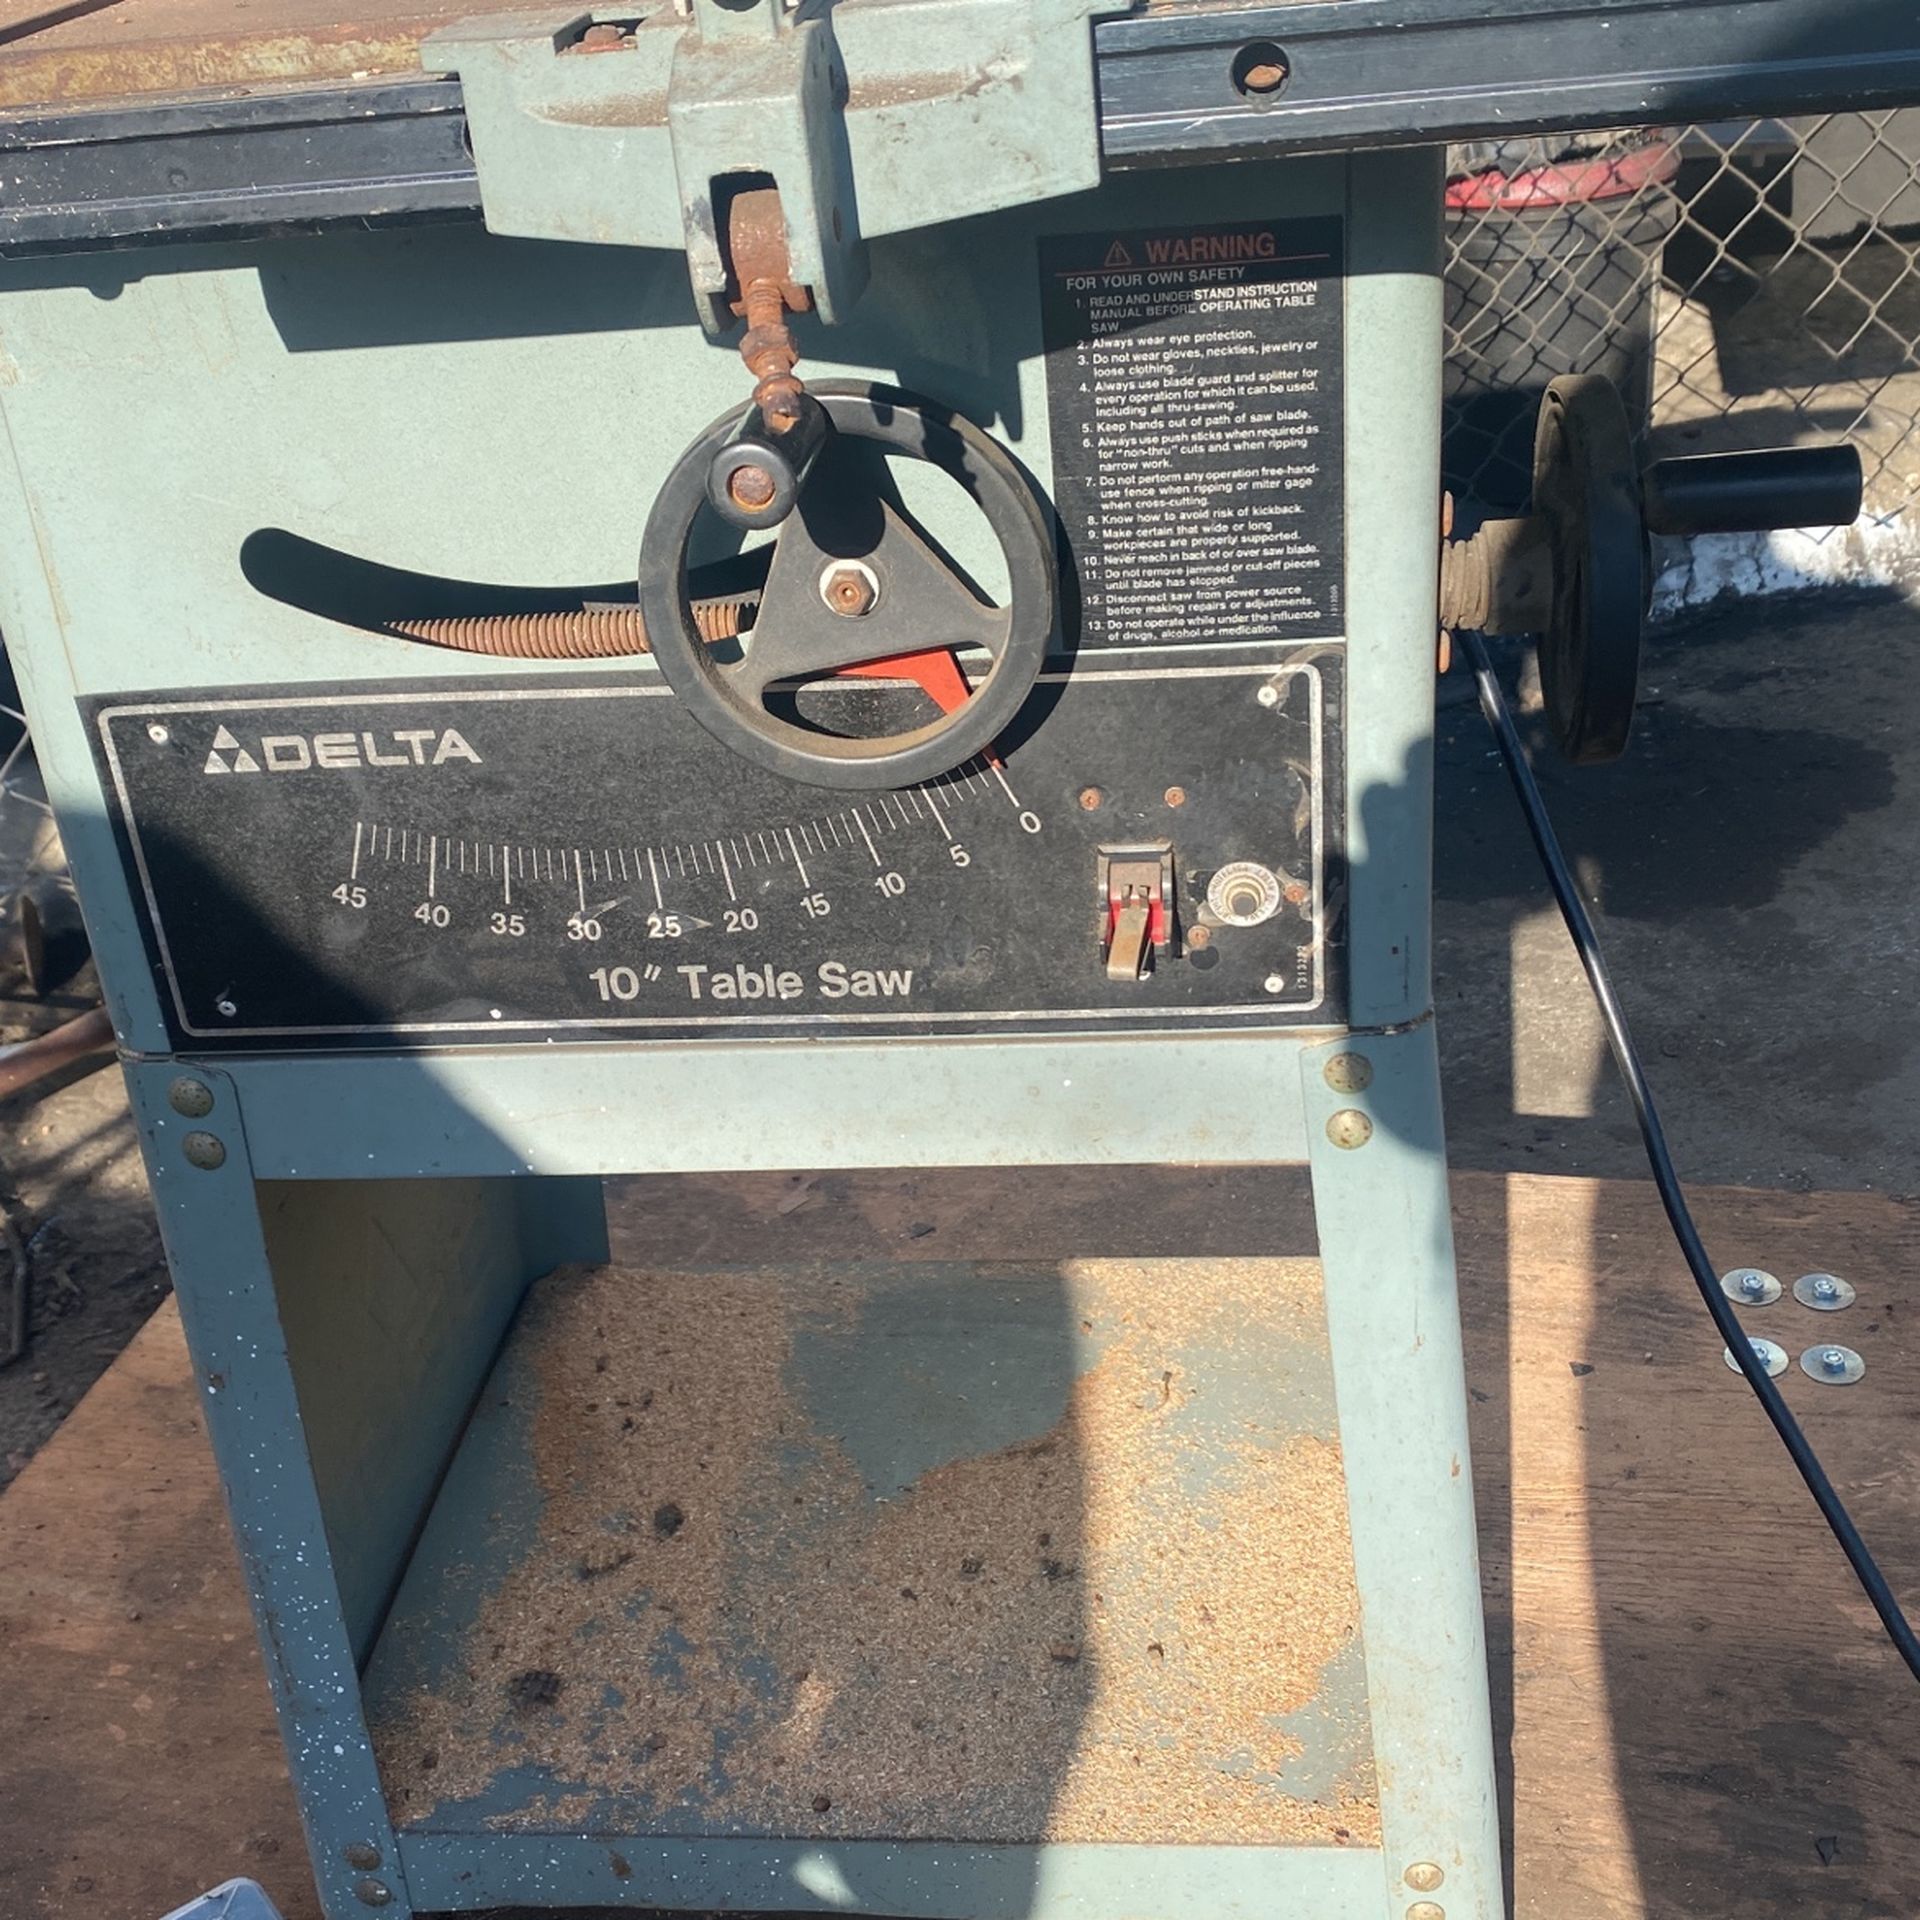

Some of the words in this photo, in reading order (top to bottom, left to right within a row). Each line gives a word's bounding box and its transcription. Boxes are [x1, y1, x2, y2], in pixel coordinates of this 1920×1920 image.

[1145, 232, 1275, 264] WARNING
[1067, 277, 1096, 289] FOR
[1102, 273, 1142, 288] YOUR
[1148, 271, 1183, 285] OWN
[1188, 267, 1245, 282] SAFETY
[1090, 296, 1122, 307] READ
[1126, 294, 1150, 305] AND
[1153, 288, 1234, 303] UNDERSTAND
[1237, 282, 1316, 297] INSTRUCTION
[1090, 307, 1141, 320] MANUAL
[1146, 303, 1194, 316] BEFORE
[1199, 298, 1270, 312] OPERATING
[1276, 295, 1314, 307] TABLE
[1077, 340, 1087, 350] 2.
[1092, 337, 1133, 351] Always
[1138, 337, 1164, 345] wear
[1169, 335, 1190, 345] eye
[1194, 328, 1255, 344] protection.
[1078, 355, 1088, 365] 3.
[1093, 354, 1108, 364] Do
[1111, 352, 1129, 363] not
[1133, 352, 1161, 361] wear
[1163, 347, 1203, 362] gloves,
[1206, 343, 1258, 359] neckties,
[1261, 340, 1303, 355] jewelry
[1306, 341, 1317, 349] or
[1080, 382, 1090, 392] 4.
[1095, 380, 1134, 393] Always
[1139, 380, 1159, 388] use
[1163, 376, 1194, 387] blade
[1197, 373, 1230, 386] guard
[1234, 371, 1255, 382] and
[1259, 368, 1298, 382] splitter
[1302, 367, 1318, 377] for
[1094, 366, 1124, 377] loose
[1129, 362, 1176, 377] clothing.
[1095, 395, 1126, 407] every
[1129, 390, 1180, 405] operation
[1183, 388, 1199, 398] for
[1202, 386, 1234, 397] which
[1237, 385, 1244, 395] it
[1247, 386, 1267, 394] can
[1270, 383, 1284, 393] be
[1082, 423, 1092, 432] 5.
[1096, 421, 1126, 434] Keep
[1130, 418, 1164, 429] hands
[1168, 417, 1186, 427] out
[1190, 416, 1202, 425] of
[1205, 414, 1230, 427] path
[1234, 413, 1246, 423] of
[1250, 413, 1272, 422] saw
[1277, 408, 1310, 420] blade.
[1096, 405, 1145, 419] including
[1151, 404, 1163, 413] all
[1083, 438, 1093, 448] 6.
[1098, 435, 1136, 449] Always
[1138, 436, 1158, 444] use
[1162, 432, 1187, 445] push
[1191, 430, 1221, 440] sticks
[1224, 428, 1254, 438] when
[1257, 424, 1303, 438] required
[1098, 449, 1113, 459] for
[1180, 443, 1203, 454] cuts
[1208, 442, 1228, 452] and
[1234, 439, 1264, 450] when
[1268, 436, 1307, 450] ripping
[1099, 462, 1137, 471] narrow
[1141, 458, 1172, 468] work.
[1085, 477, 1095, 487] 7.
[1099, 476, 1114, 486] Do
[1117, 474, 1135, 485] not
[1138, 472, 1181, 486] perform
[1184, 472, 1203, 483] any
[1206, 467, 1259, 482] operation
[1101, 490, 1120, 498] use
[1124, 486, 1154, 497] fence
[1159, 484, 1190, 494] when
[1194, 481, 1232, 495] ripping
[1236, 482, 1248, 490] or
[1252, 478, 1280, 489] miter
[1285, 478, 1312, 489] gage
[1087, 516, 1098, 525] 8.
[1102, 514, 1133, 524] Know
[1137, 512, 1160, 522] how
[1164, 511, 1175, 520] to
[1180, 509, 1208, 519] avoid
[1213, 507, 1233, 517] risk
[1237, 506, 1248, 516] of
[1252, 503, 1304, 515] kickback.
[1101, 500, 1131, 510] when
[1088, 530, 1098, 539] 9.
[1102, 528, 1132, 538] Make
[1136, 526, 1172, 536] certain
[1176, 524, 1198, 534] that
[1202, 523, 1228, 532] wide
[1248, 520, 1272, 532] long
[1103, 538, 1165, 552] workpieces
[1191, 534, 1237, 547] properly
[1240, 530, 1301, 544] supported.
[1104, 554, 1135, 564] Never
[1138, 552, 1167, 562] reach
[1170, 552, 1179, 561] in
[1182, 550, 1206, 560] back
[1209, 549, 1220, 558] of
[1222, 550, 1234, 558] or
[1236, 549, 1260, 557] over
[1263, 547, 1283, 555] saw
[1286, 543, 1319, 554] blade.
[1084, 570, 1101, 580] 11.
[1105, 569, 1121, 579] Do
[1123, 568, 1139, 578] not
[1142, 568, 1182, 577] remove
[1186, 563, 1228, 576] jammed
[1231, 564, 1242, 572] or
[1245, 560, 1280, 571] cut-off
[1283, 557, 1320, 570] pieces
[1108, 620, 1123, 629] Do
[1125, 619, 1142, 628] not
[1144, 616, 1185, 629] operate
[1187, 615, 1214, 625] while
[1217, 613, 1248, 623] under
[1251, 612, 1268, 621] the
[1270, 609, 1320, 620] influence
[261, 728, 482, 770] DELTA
[332, 883, 367, 909] 45
[414, 903, 450, 928] 40
[490, 913, 525, 936] 35
[567, 917, 602, 942] 30
[647, 916, 682, 939] 25
[722, 908, 759, 933] 20
[799, 892, 832, 918] 15
[874, 871, 907, 898] 10
[949, 843, 971, 868] 5
[1018, 811, 1042, 834] 0
[588, 965, 660, 1002] 10"
[678, 963, 805, 1000] Table
[818, 962, 913, 997] Saw
